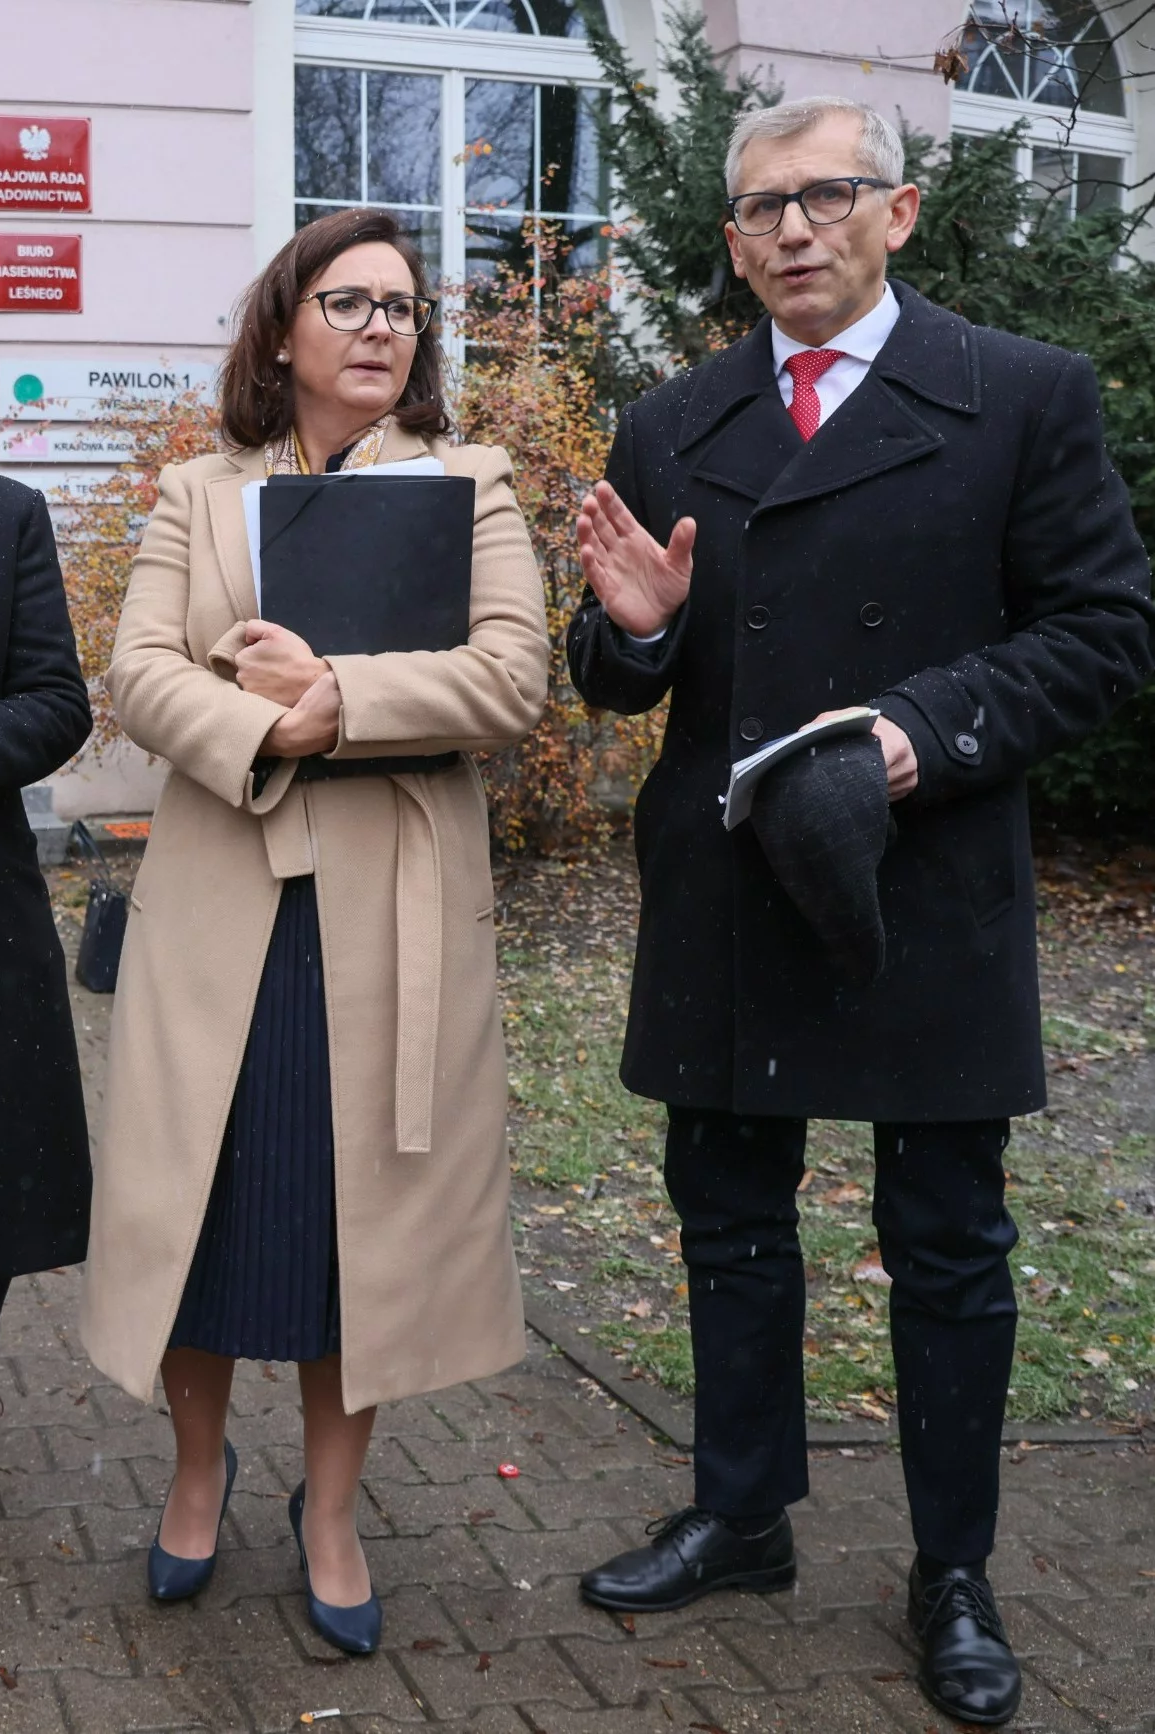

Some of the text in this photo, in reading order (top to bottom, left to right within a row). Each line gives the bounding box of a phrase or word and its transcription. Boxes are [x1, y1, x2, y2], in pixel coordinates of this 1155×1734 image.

[49, 171, 86, 185] RADA
[16, 244, 54, 258] BIURO
[8, 284, 64, 301] LEŚNEGO
[88, 371, 191, 390] PAWILON 1
[53, 442, 105, 452] KRAJOWA
